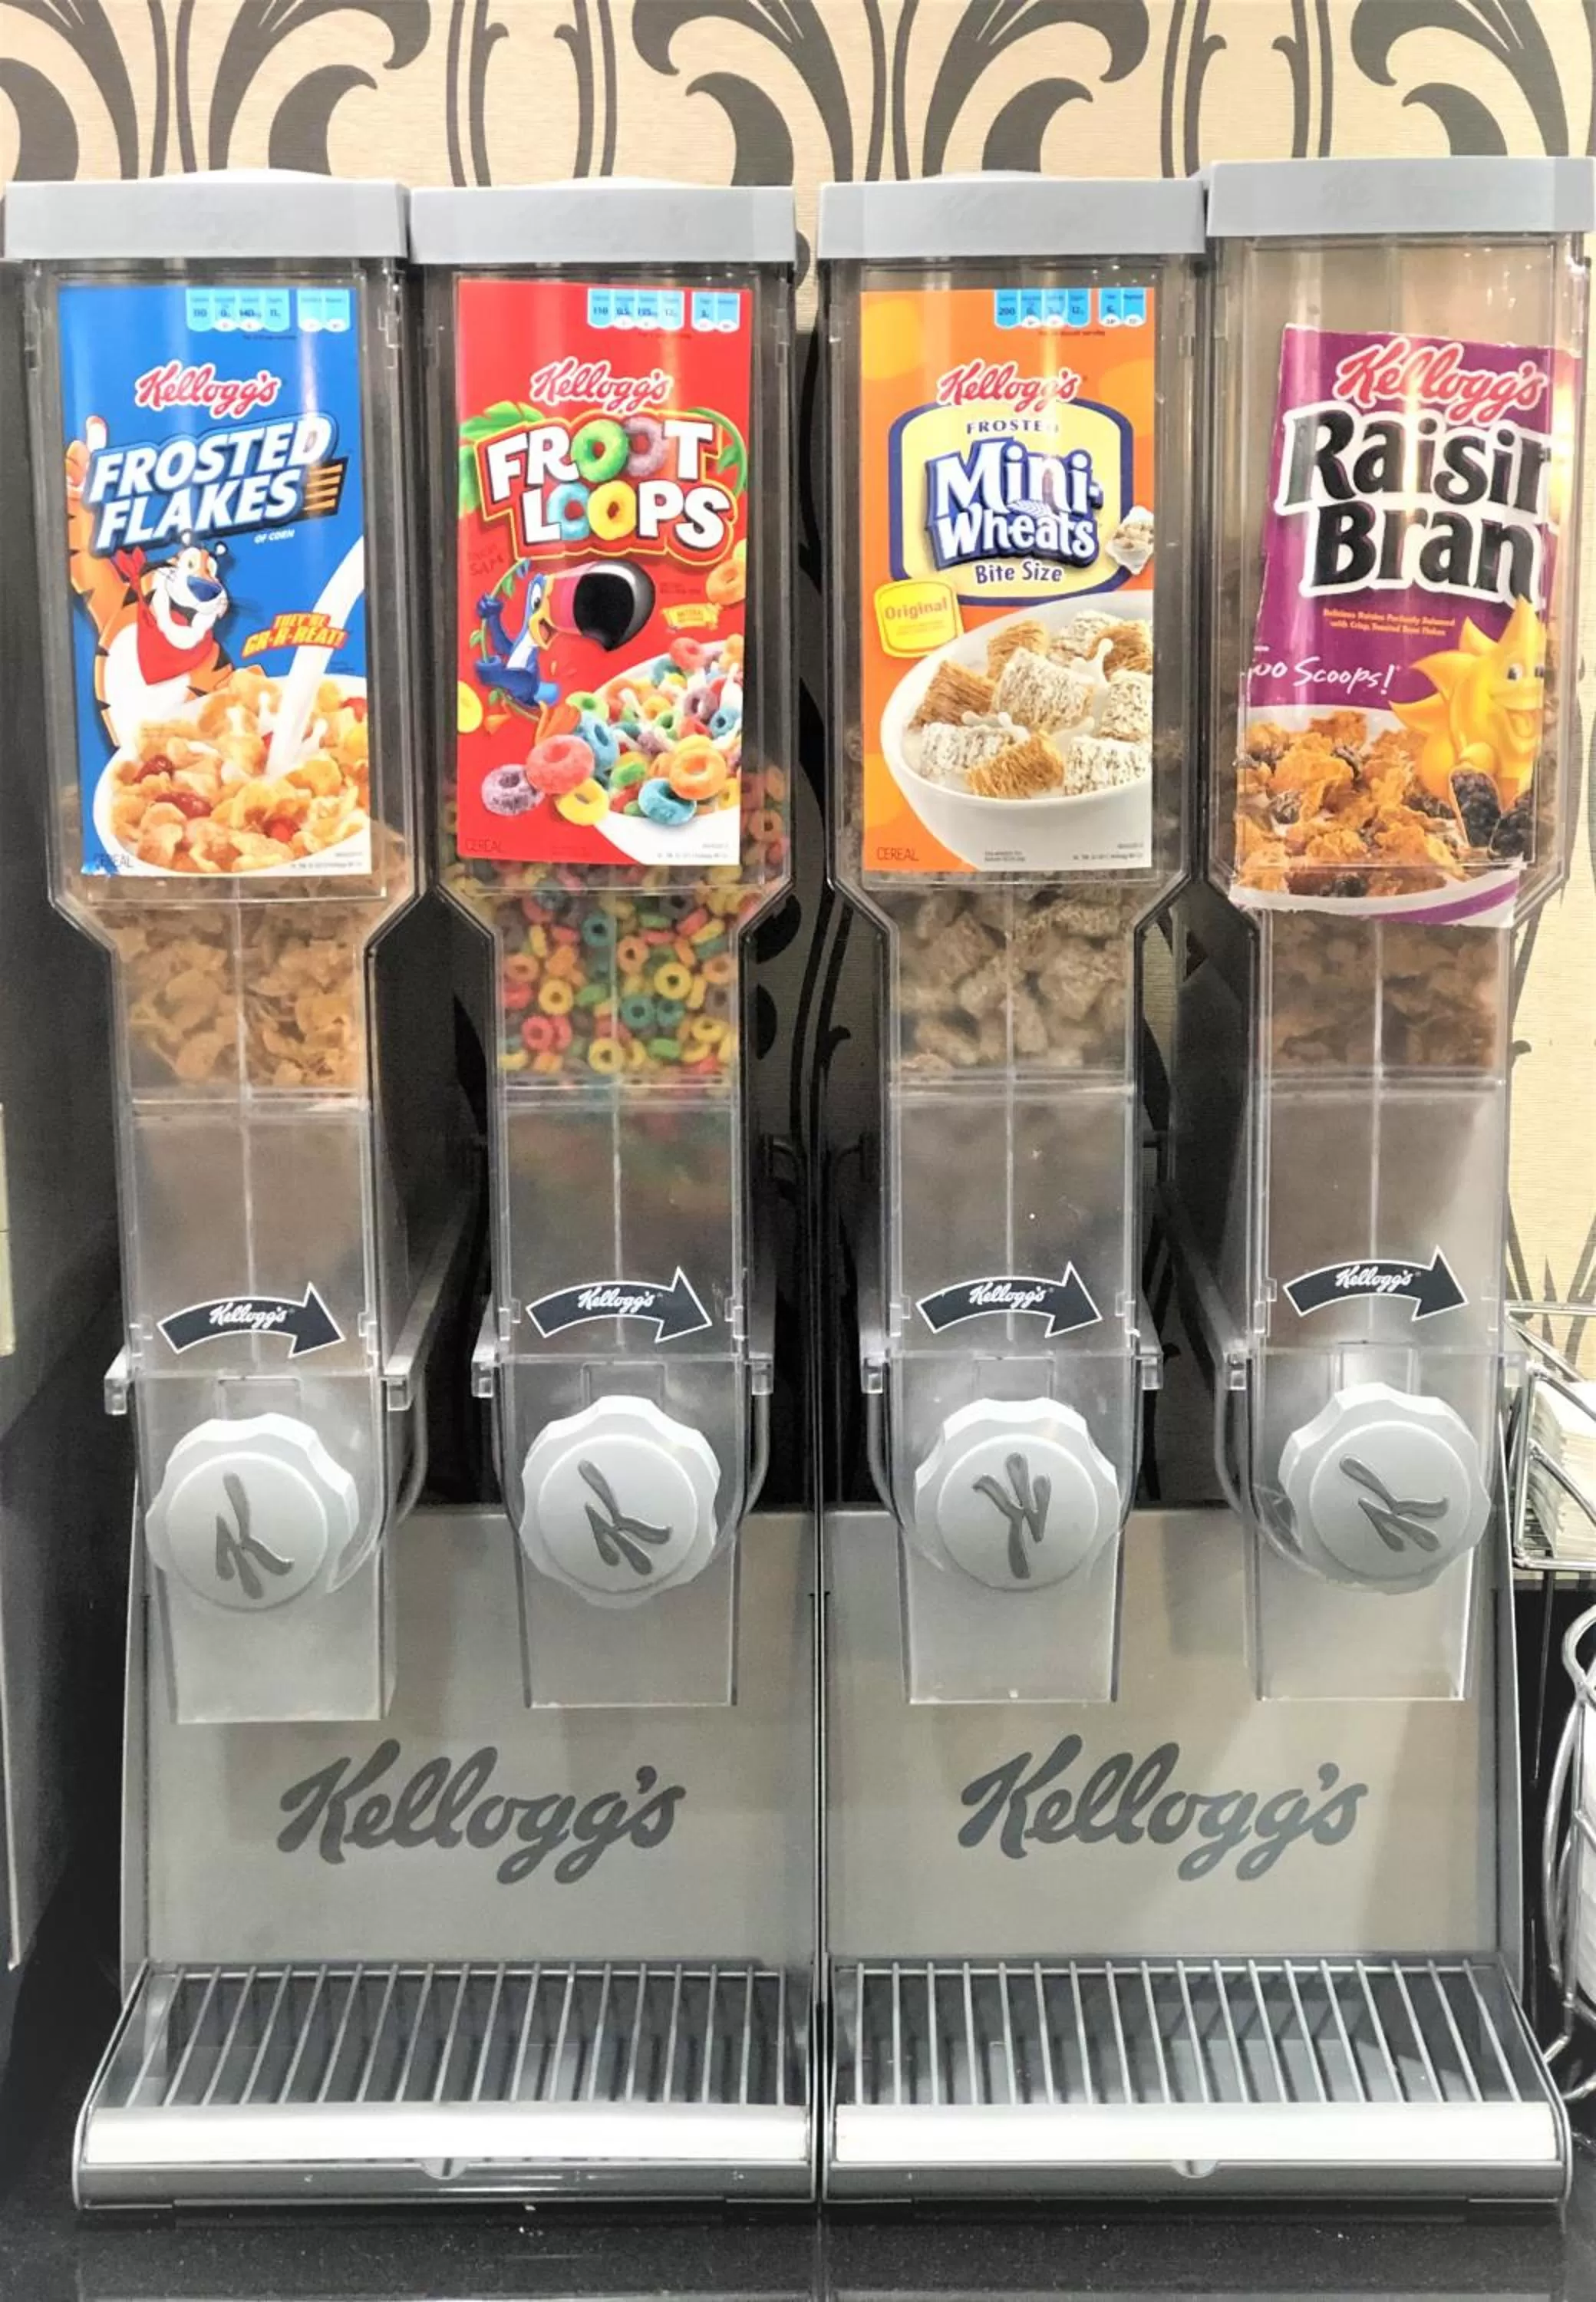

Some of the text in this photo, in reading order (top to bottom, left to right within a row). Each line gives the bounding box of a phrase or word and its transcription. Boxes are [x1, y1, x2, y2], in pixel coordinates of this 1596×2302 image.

[136, 362, 280, 418] Kellogg's
[533, 360, 670, 412] Kellogg's
[939, 362, 1077, 412] Kellogg's
[1337, 342, 1545, 422] Kellogg's
[88, 417, 332, 503] FROSTED
[486, 417, 712, 502] FROOT
[937, 441, 1101, 516] Mini-
[95, 469, 302, 550] FLAKES
[522, 479, 730, 549] LOOPS
[938, 504, 1095, 559] Wheats
[975, 561, 1062, 583] Bite Size
[1312, 501, 1534, 603] Bran
[885, 597, 947, 620] Original
[1292, 656, 1395, 694] Scoops!
[877, 846, 919, 861] CEREAL
[578, 1286, 655, 1313] Kellogg's
[969, 1281, 1047, 1309] Kellogg's
[1335, 1265, 1413, 1292] Kellogg's
[209, 1302, 288, 1330] Kellogg's
[277, 1738, 686, 1884] Kellogg's
[958, 1733, 1368, 1882] Kellogg's
